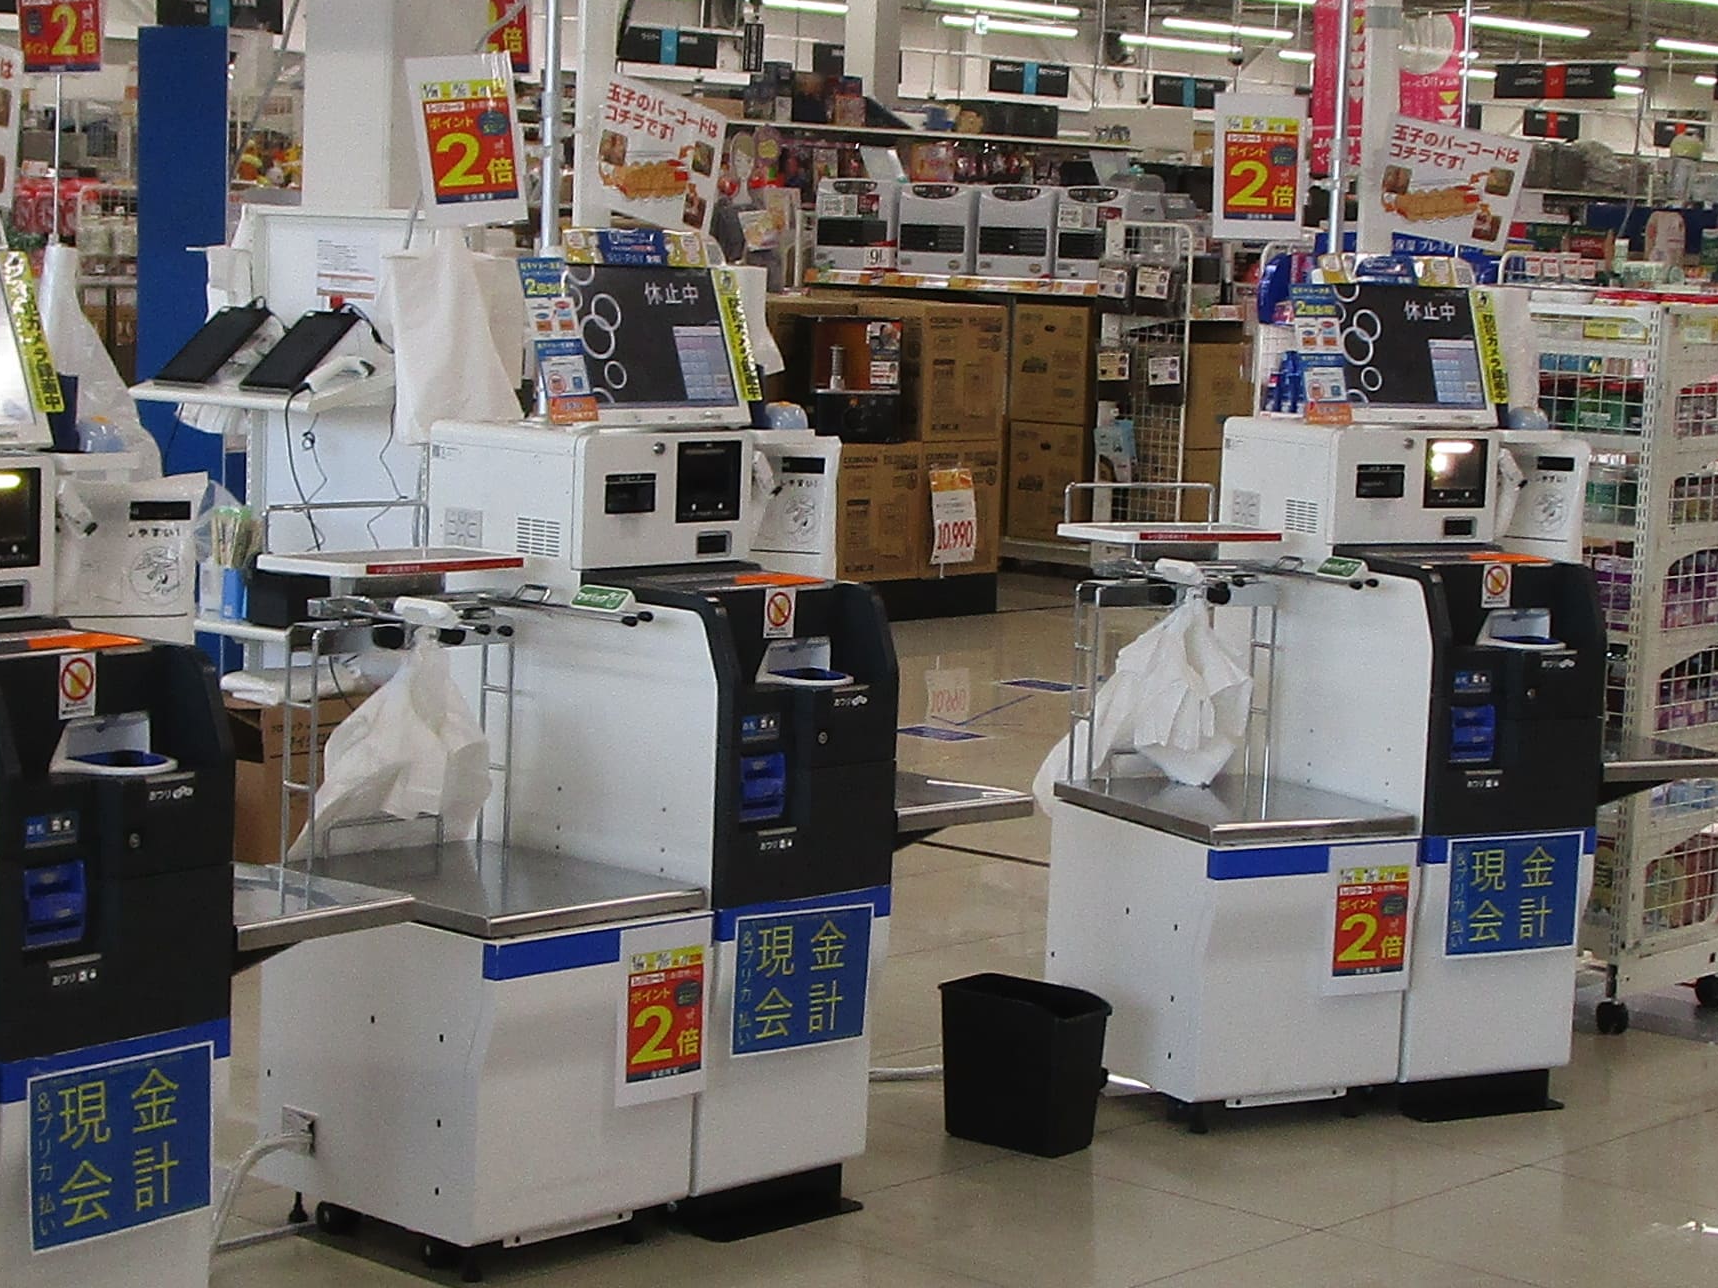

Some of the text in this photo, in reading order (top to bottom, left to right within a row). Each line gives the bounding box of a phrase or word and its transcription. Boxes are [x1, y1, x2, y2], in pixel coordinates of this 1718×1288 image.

[429, 116, 474, 130] ポイント
[605, 104, 675, 142] コチラです!
[606, 81, 718, 139] 玉子のバーコードは
[1389, 143, 1466, 171] コチラです!
[1394, 123, 1521, 164] 玉子のバーコードは
[645, 282, 699, 305] 休止中
[1404, 300, 1457, 322] 休止中
[936, 521, 975, 552] 10,990
[1470, 845, 1555, 892] 現金
[1468, 895, 1553, 942] 会計
[756, 919, 846, 978] 現金
[630, 987, 671, 1005] ポイント
[755, 979, 844, 1040] 会計
[58, 1067, 180, 1150] 現金
[59, 1140, 180, 1227] 会計
